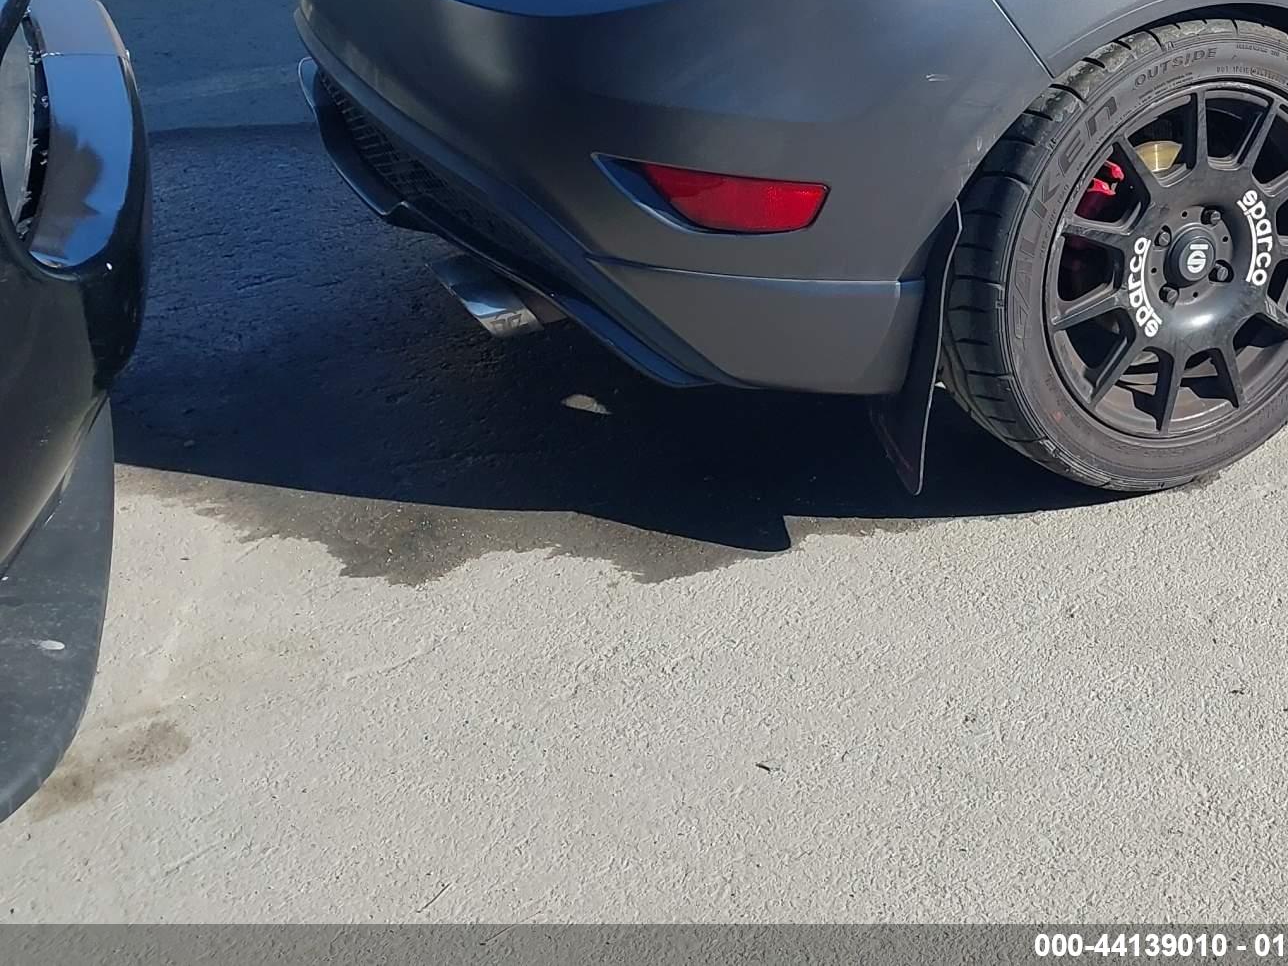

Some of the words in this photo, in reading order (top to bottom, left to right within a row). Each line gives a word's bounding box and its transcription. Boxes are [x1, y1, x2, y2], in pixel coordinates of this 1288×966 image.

[1134, 47, 1218, 87] OUTSIDE
[1242, 190, 1273, 286] sparco
[1128, 237, 1161, 337] sparco
